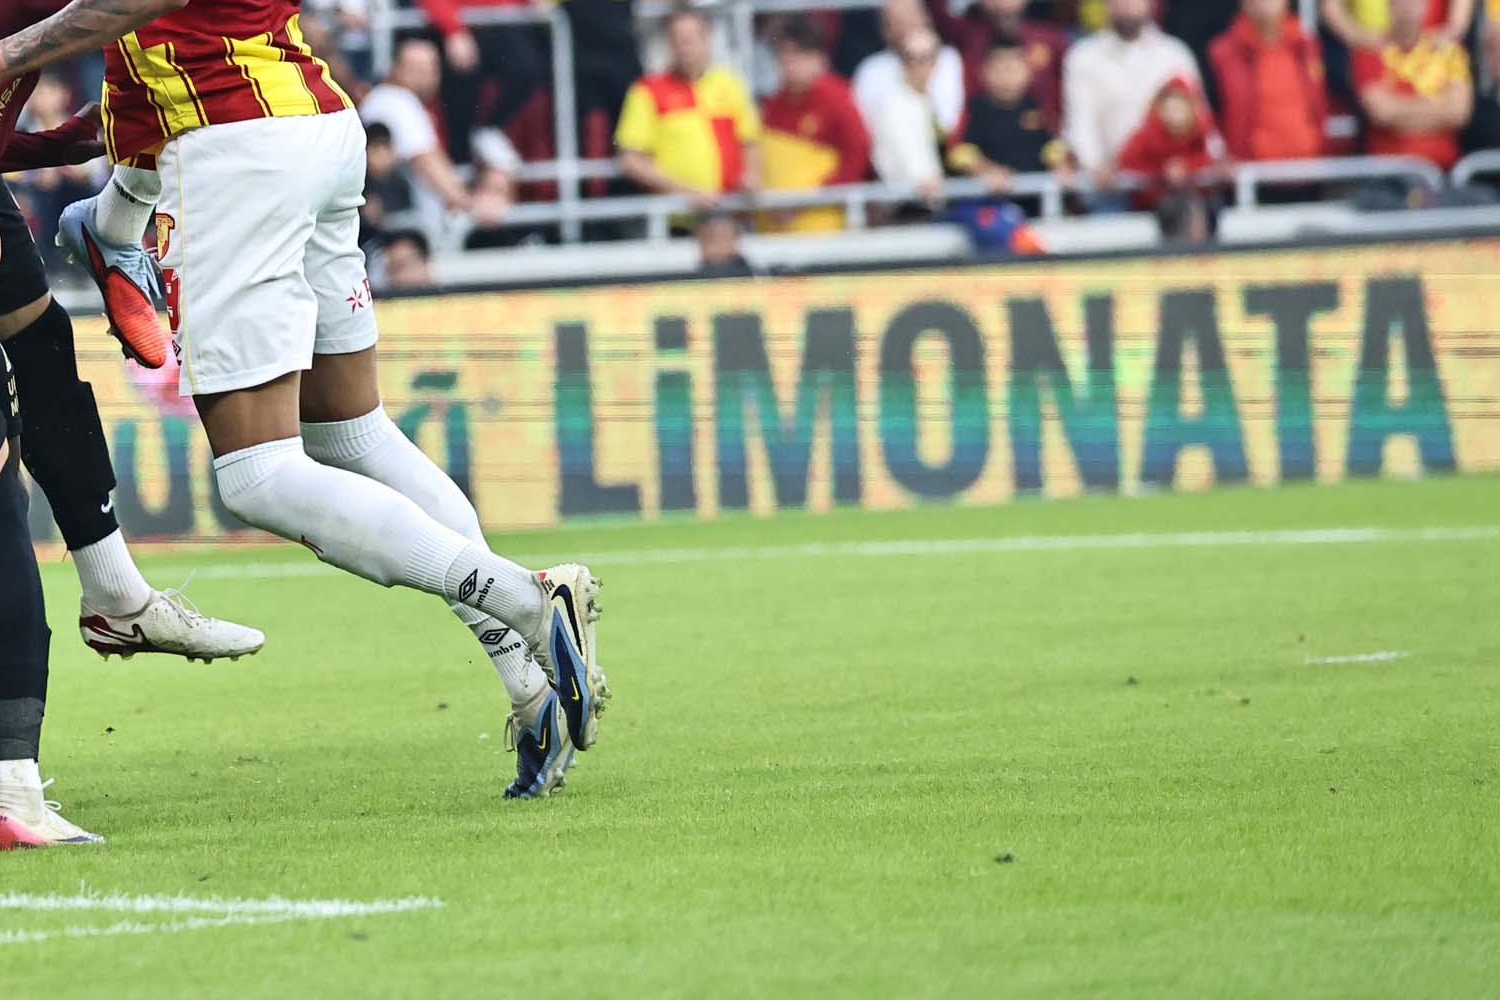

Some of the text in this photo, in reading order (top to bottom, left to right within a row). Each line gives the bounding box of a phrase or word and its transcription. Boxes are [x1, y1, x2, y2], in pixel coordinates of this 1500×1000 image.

[556, 274, 1456, 517] LiMONATA
[475, 577, 495, 608] umbro
[488, 641, 521, 658] umbro
